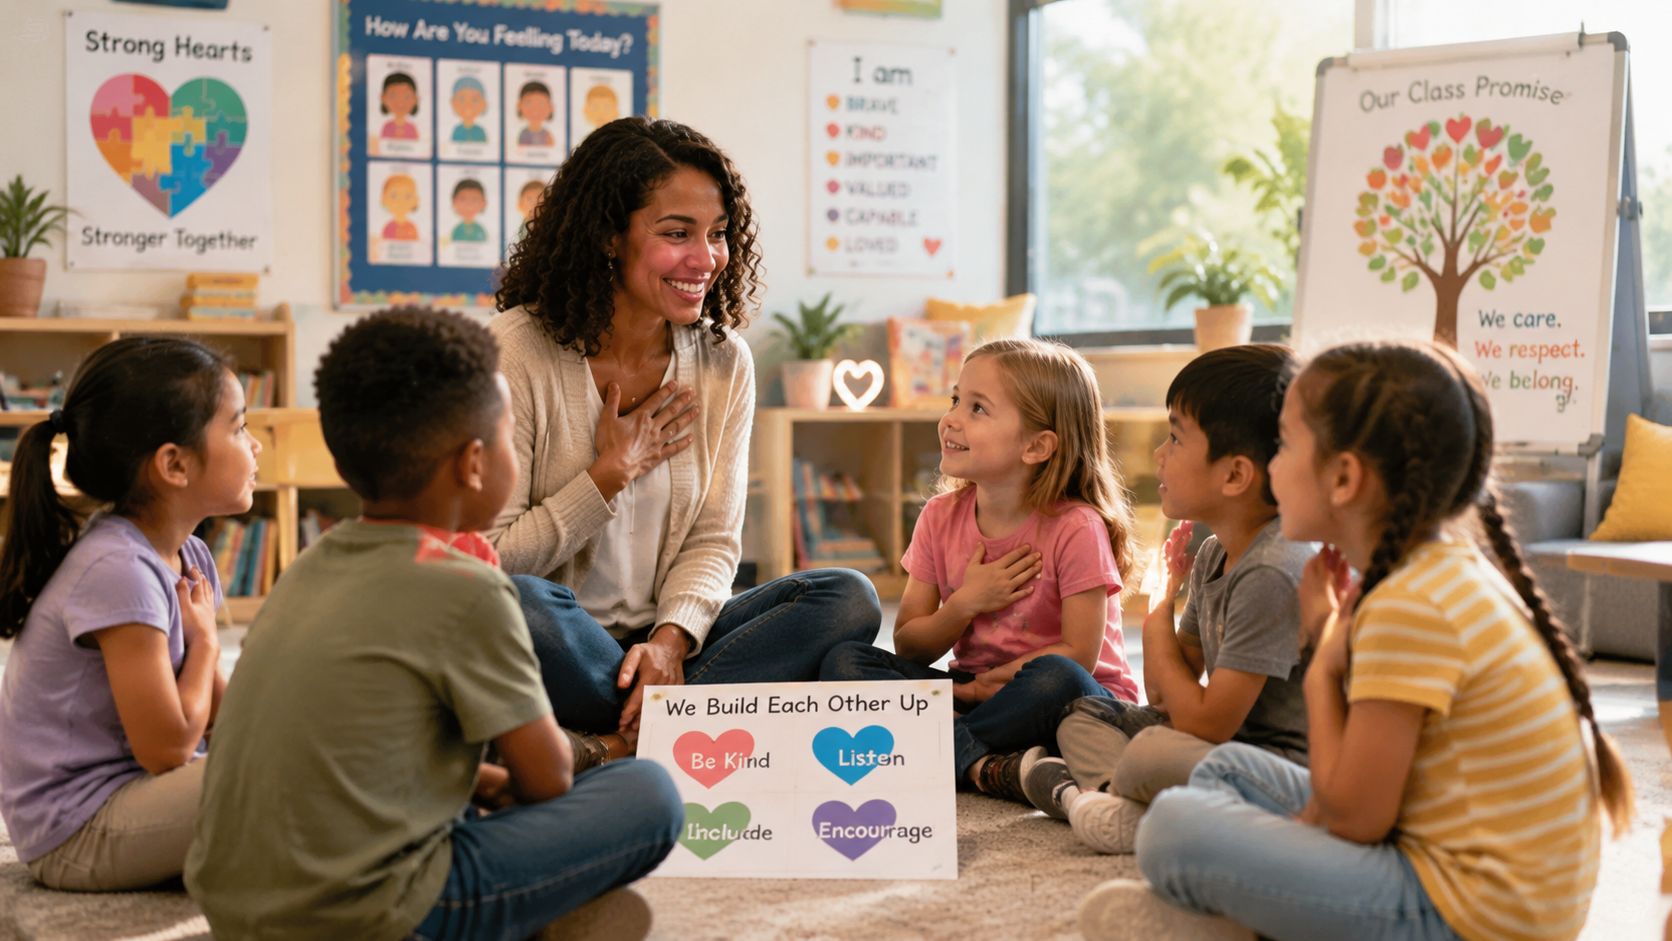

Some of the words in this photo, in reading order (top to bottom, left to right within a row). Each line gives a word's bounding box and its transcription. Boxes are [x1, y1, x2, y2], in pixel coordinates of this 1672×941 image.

[85, 30, 165, 62] Strong
[175, 35, 253, 63] Hearts
[365, 14, 409, 38] How
[412, 18, 450, 41] Are
[453, 21, 490, 44] You
[566, 28, 634, 59] Today?
[853, 56, 863, 84] I
[873, 66, 914, 85] am
[1359, 89, 1400, 113] Our
[1408, 80, 1466, 104] Class
[1475, 75, 1565, 105] Promise
[81, 226, 168, 252] Stronger
[175, 228, 258, 254] Together
[1478, 309, 1505, 328] We
[1513, 312, 1562, 328] care.
[1474, 339, 1502, 358] We
[1509, 338, 1585, 364] respect.
[665, 698, 696, 716] We
[706, 696, 758, 715] Build
[768, 695, 819, 714] Each
[828, 694, 891, 713] Other
[900, 694, 929, 716] Up
[691, 752, 717, 770] Be
[724, 751, 770, 769] Kind
[838, 749, 906, 767] Listen
